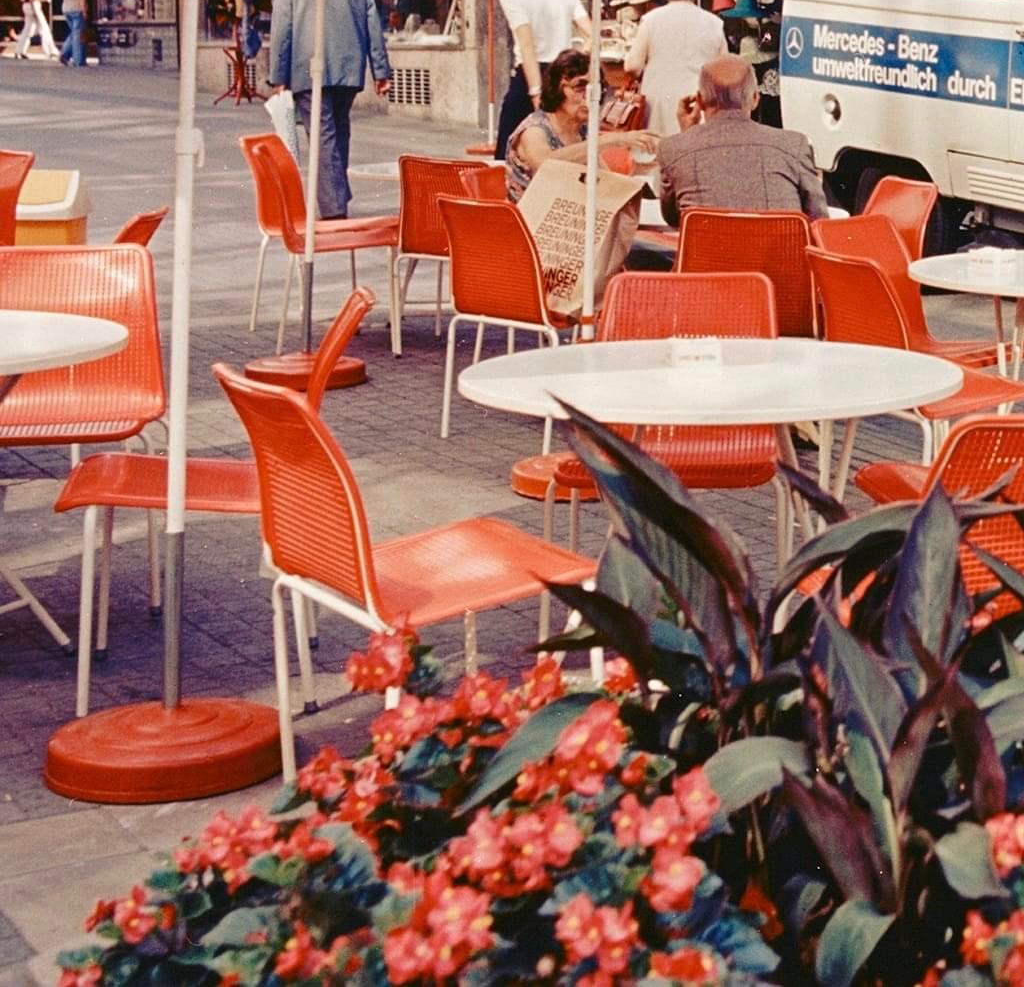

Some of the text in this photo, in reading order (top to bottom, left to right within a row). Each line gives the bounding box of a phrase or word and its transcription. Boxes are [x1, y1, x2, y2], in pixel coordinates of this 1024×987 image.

[812, 23, 885, 56] Mercedes
[898, 34, 939, 63] Benz
[812, 55, 937, 92] umweltfreundlich
[947, 68, 997, 102] durch
